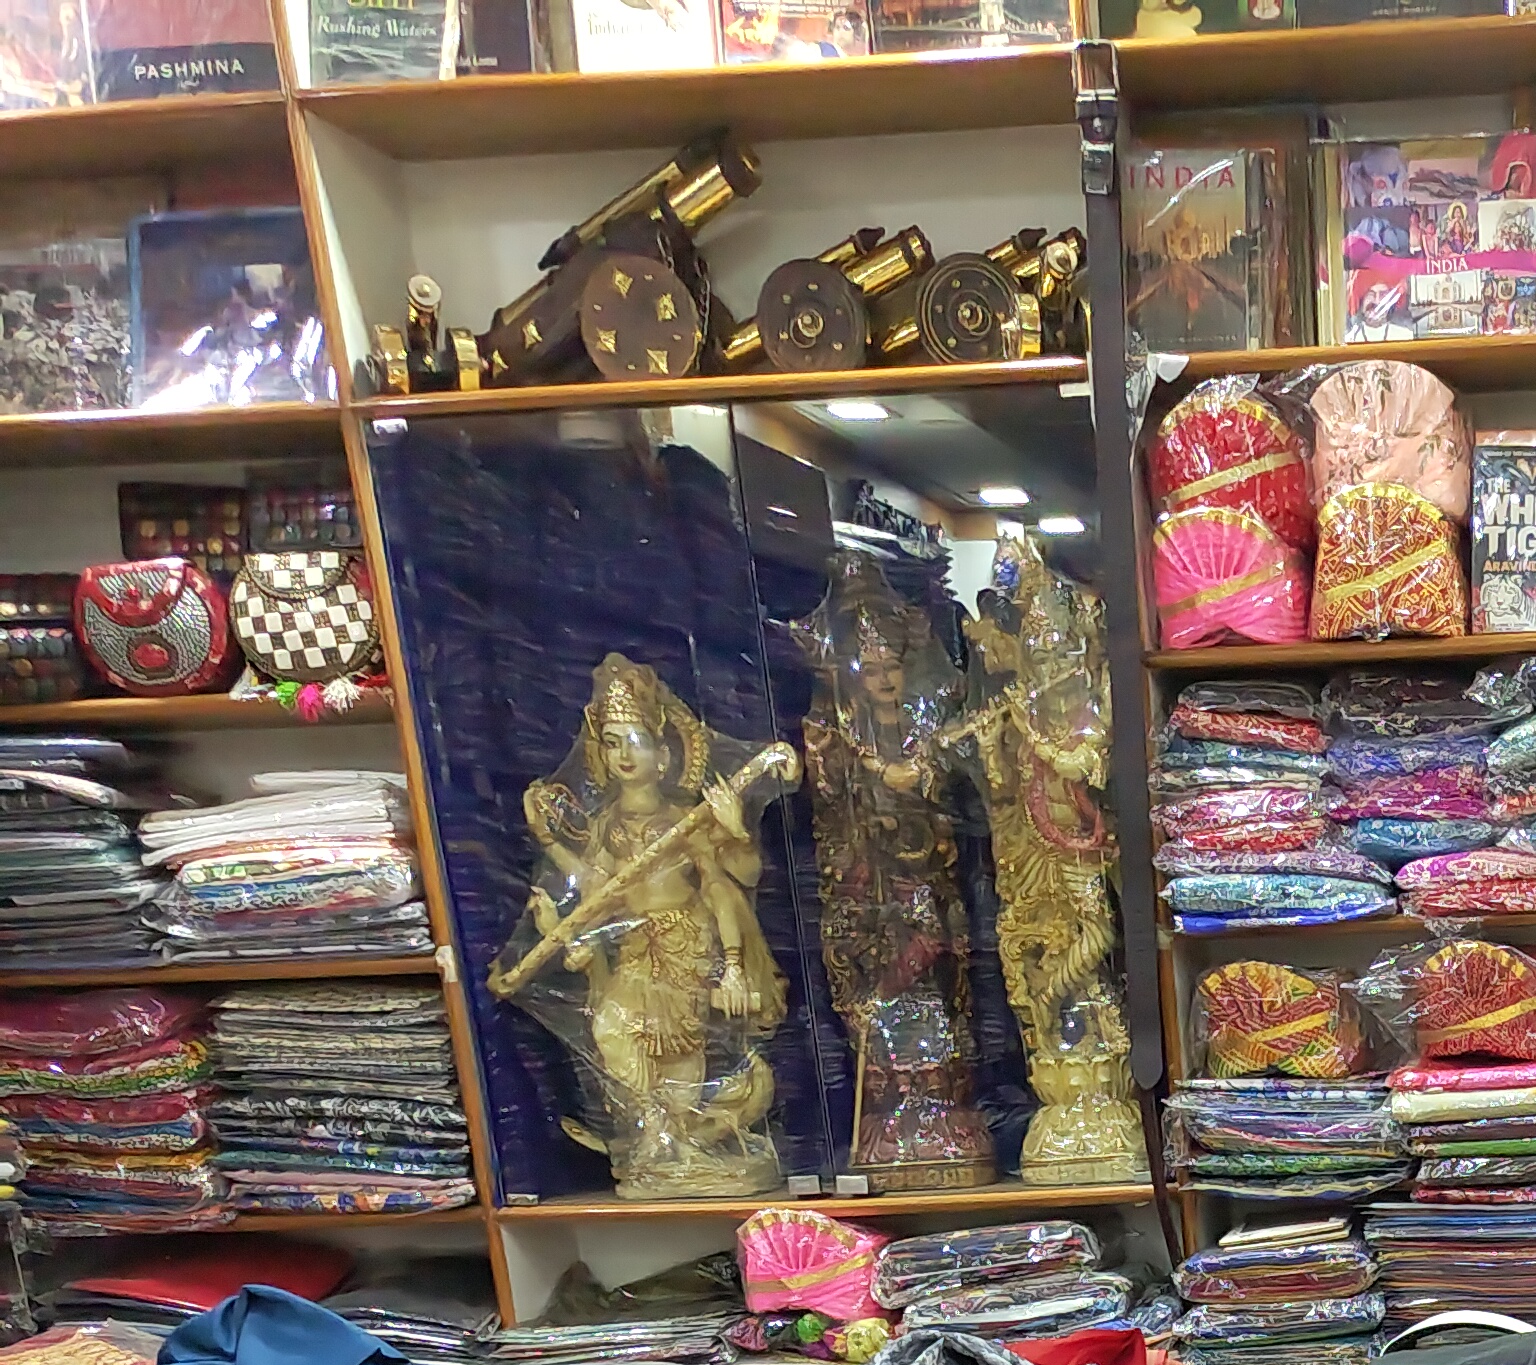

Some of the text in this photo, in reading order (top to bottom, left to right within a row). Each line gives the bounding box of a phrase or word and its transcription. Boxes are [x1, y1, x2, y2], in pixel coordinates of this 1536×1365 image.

[318, 15, 381, 38] Rushing
[134, 58, 244, 81] PASHMINA
[1129, 165, 1236, 190] INDIA
[1426, 257, 1469, 274] INDIA
[1485, 477, 1511, 493] THE
